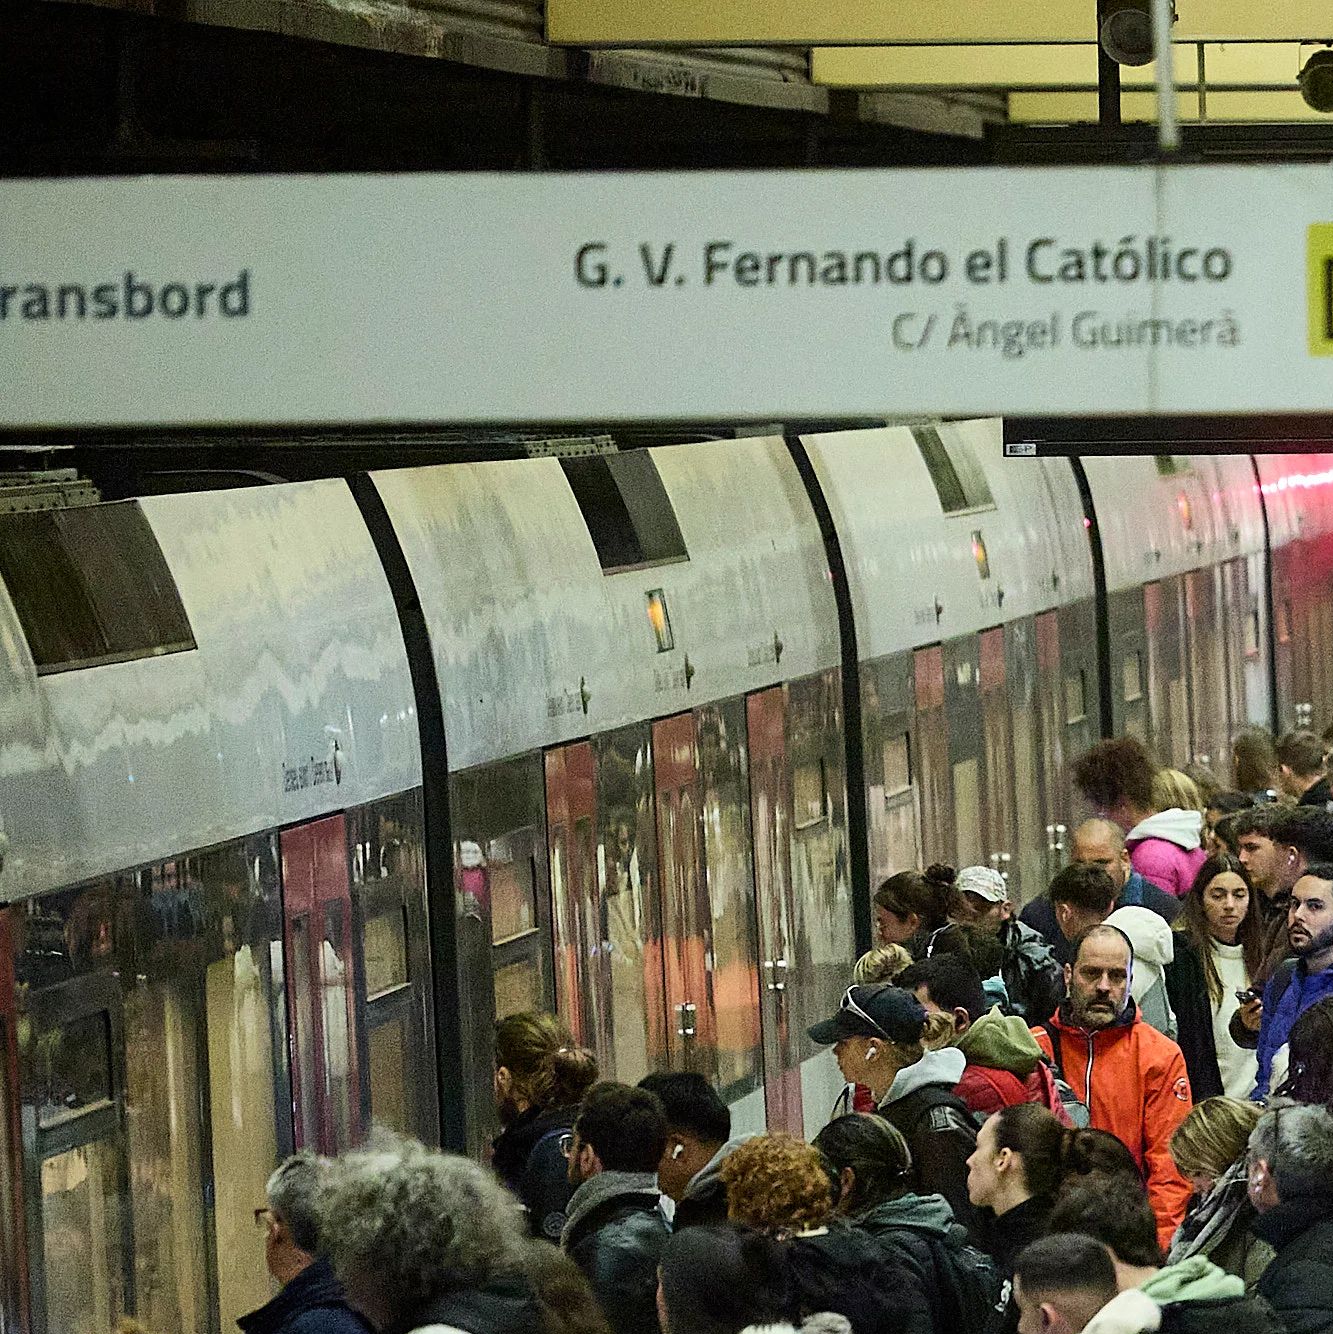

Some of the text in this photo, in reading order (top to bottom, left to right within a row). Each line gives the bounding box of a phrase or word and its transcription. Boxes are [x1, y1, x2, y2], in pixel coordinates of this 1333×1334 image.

[574, 234, 1232, 287] G. V. Fernando el Católico
[892, 312, 938, 351] C/
